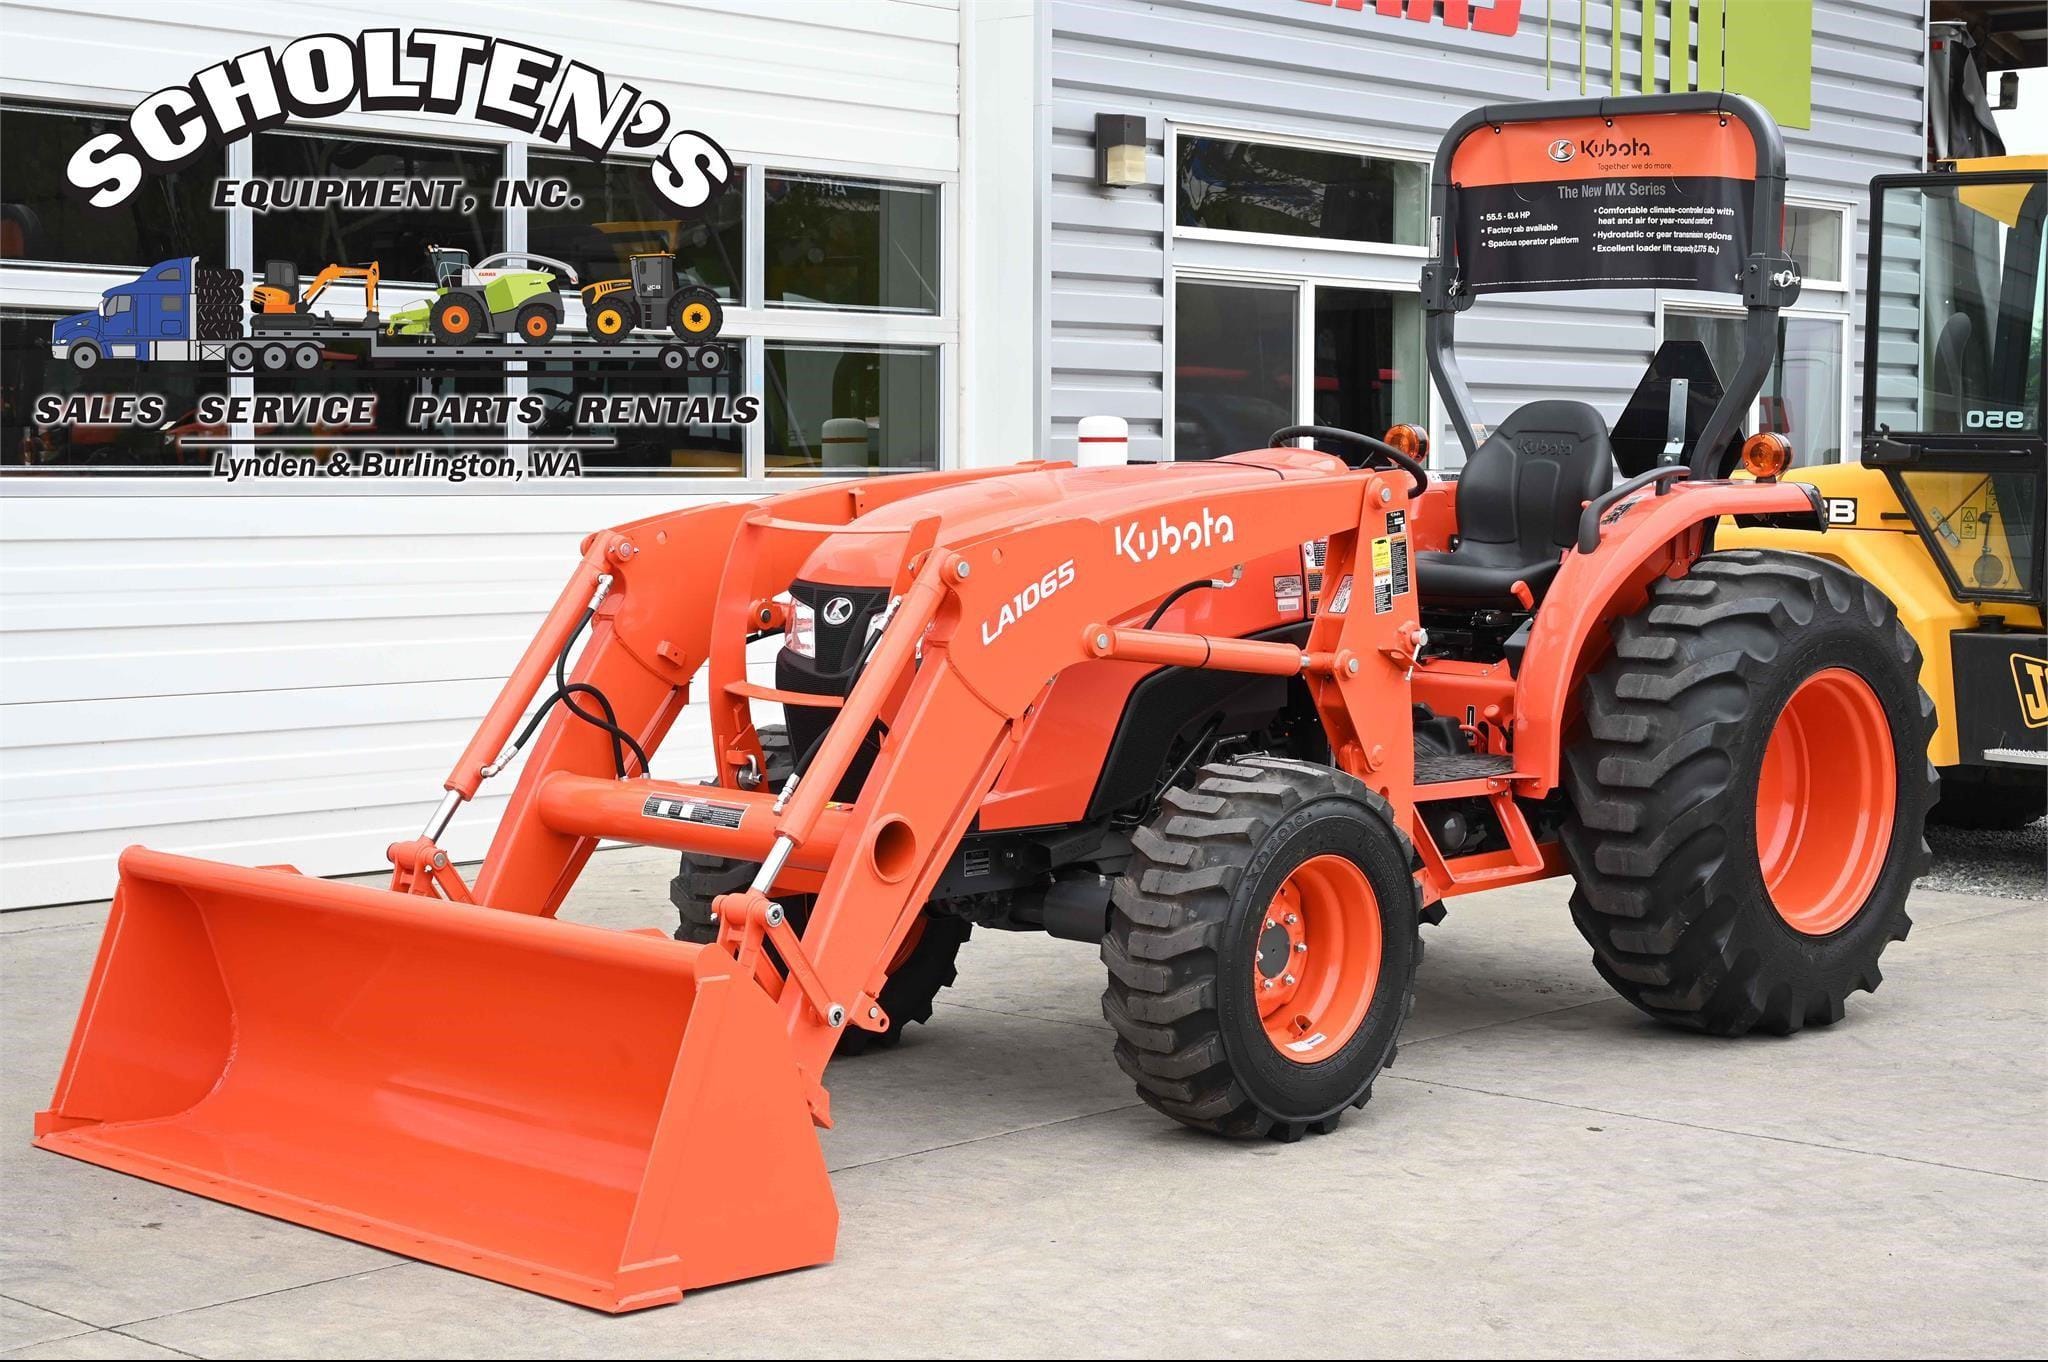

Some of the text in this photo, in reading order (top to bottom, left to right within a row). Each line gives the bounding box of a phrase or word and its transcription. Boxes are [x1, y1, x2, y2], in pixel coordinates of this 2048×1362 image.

[1580, 138, 1650, 157] Kubota
[1598, 163, 1629, 171] Together
[1558, 181, 1666, 199] The New MX Series
[1520, 211, 1530, 219] HP
[1598, 206, 1648, 215] Comfortable
[1716, 207, 1735, 216] with
[1635, 216, 1646, 224] air
[1647, 216, 1659, 224] for
[1487, 226, 1512, 234] Factory
[1525, 223, 1558, 232] available
[1597, 230, 1645, 240] Hydrostatic
[1656, 231, 1672, 240] gear
[1704, 231, 1733, 241] options
[1488, 236, 1579, 248] Spacious operator platform
[1597, 244, 1635, 252] Excellent
[1636, 244, 1661, 252] loader
[1662, 244, 1672, 252] lift
[1114, 507, 1234, 563] Kubota
[981, 559, 1076, 647] LA1065
